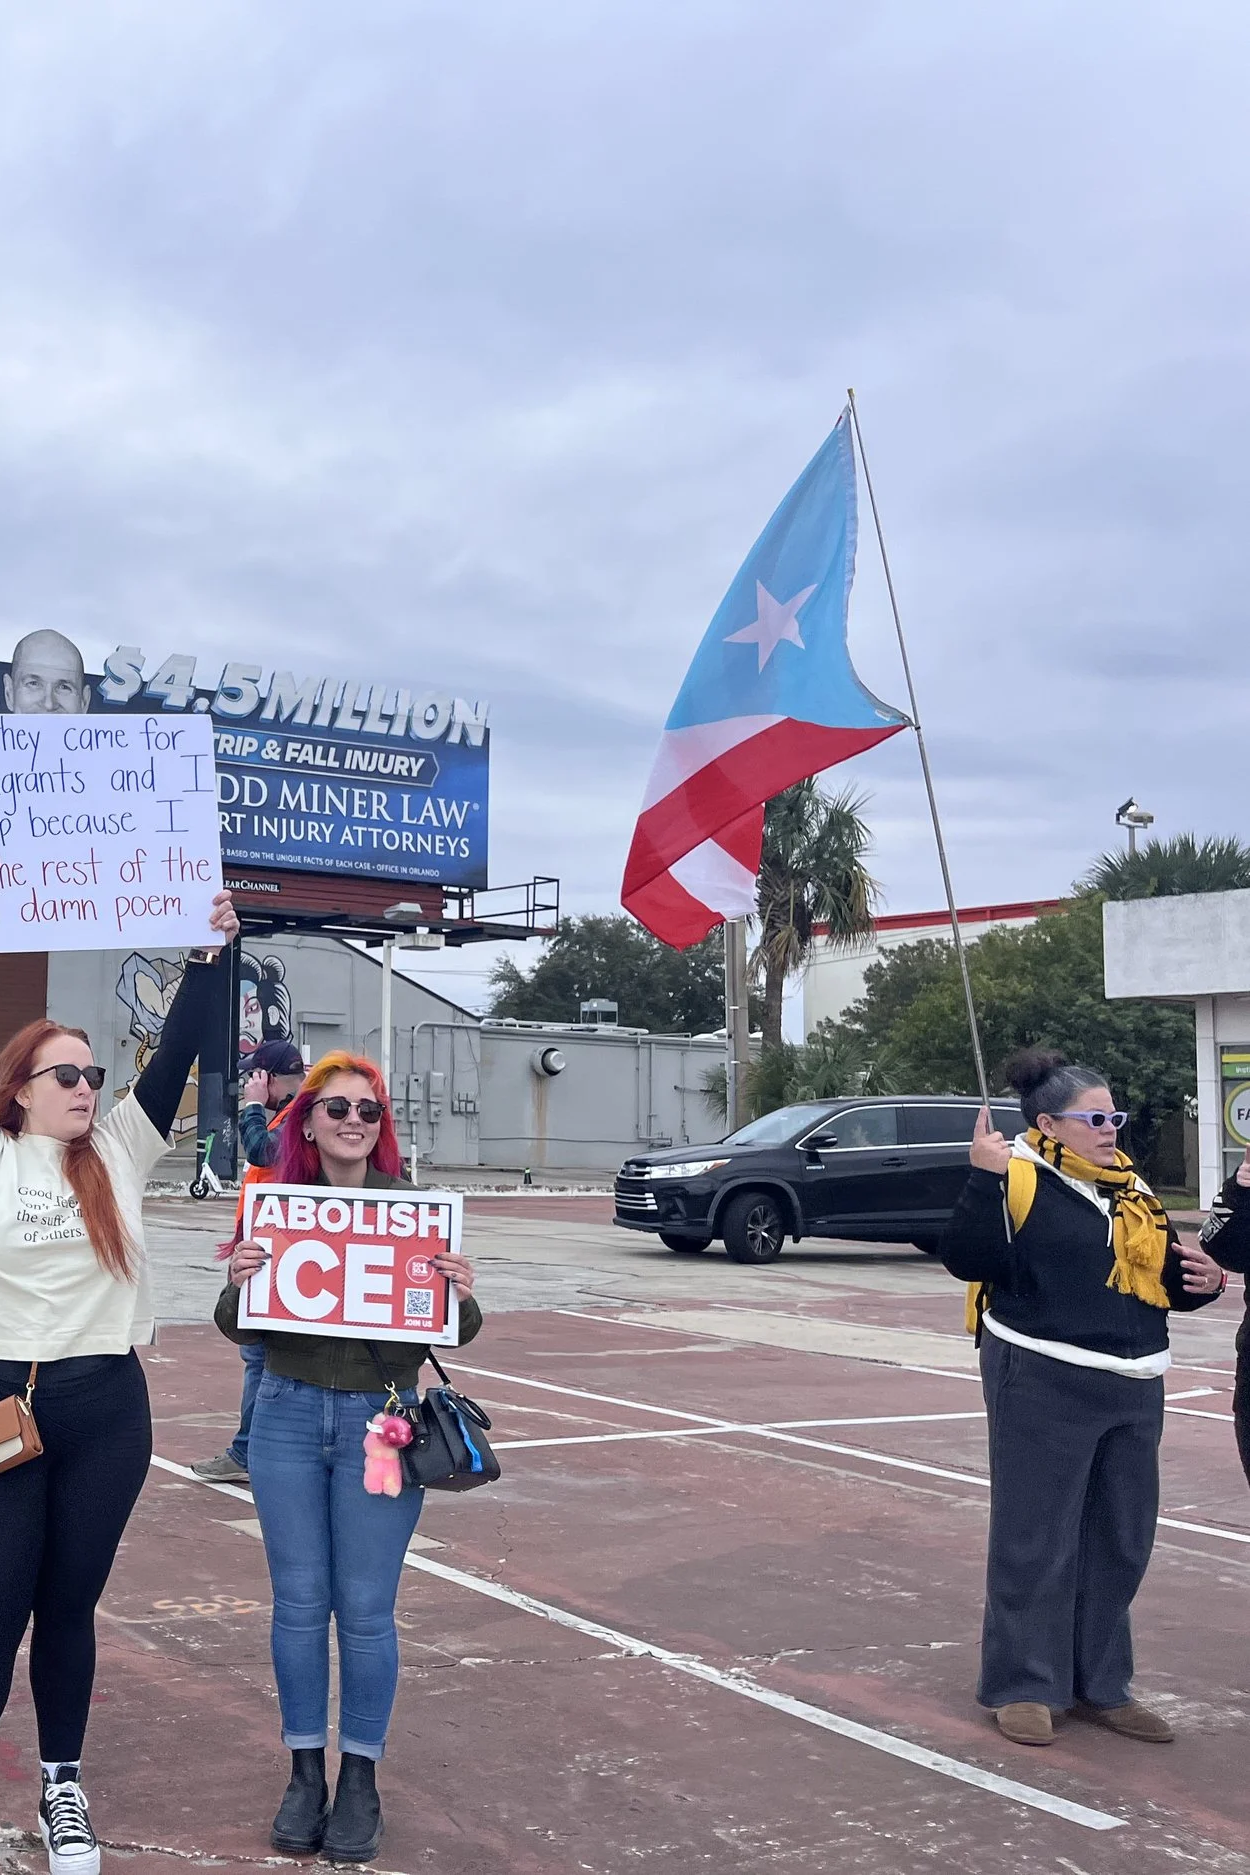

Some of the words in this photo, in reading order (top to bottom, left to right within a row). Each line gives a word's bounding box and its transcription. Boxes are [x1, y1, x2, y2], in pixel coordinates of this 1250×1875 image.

[259, 669, 490, 748] MILLION
[64, 725, 129, 751] came
[140, 718, 186, 751] for
[110, 756, 157, 792] and
[180, 754, 214, 792] I
[261, 739, 282, 761] &
[284, 741, 340, 768] FALL
[343, 749, 426, 777] INJURY
[215, 773, 269, 807] DD
[277, 780, 394, 822] MINER
[28, 806, 138, 838] because
[155, 799, 189, 832] I
[253, 815, 335, 844] INJURY
[339, 825, 470, 858] ATTORNEYS
[41, 847, 103, 885] rest
[119, 848, 147, 884] of
[161, 846, 213, 882] the
[226, 848, 248, 858] BASED
[250, 851, 260, 859] ON
[262, 852, 275, 861] THE
[276, 853, 302, 864] UNIQUE
[303, 856, 324, 866] FACTS
[324, 859, 334, 867] OF
[336, 859, 353, 869] EACH
[354, 861, 371, 871] CASE
[376, 864, 400, 874] OFFICE
[400, 866, 408, 874] IN
[409, 867, 440, 878] ORLANDO
[20, 887, 98, 923] damn
[115, 894, 188, 931] poem.
[18, 1186, 53, 1200] Good
[16, 1210, 38, 1223] the
[253, 1194, 450, 1239] ABOLISH
[24, 1230, 39, 1242] of
[248, 1236, 395, 1325] ICE
[404, 1318, 421, 1327] JOIN
[422, 1320, 433, 1328] US
